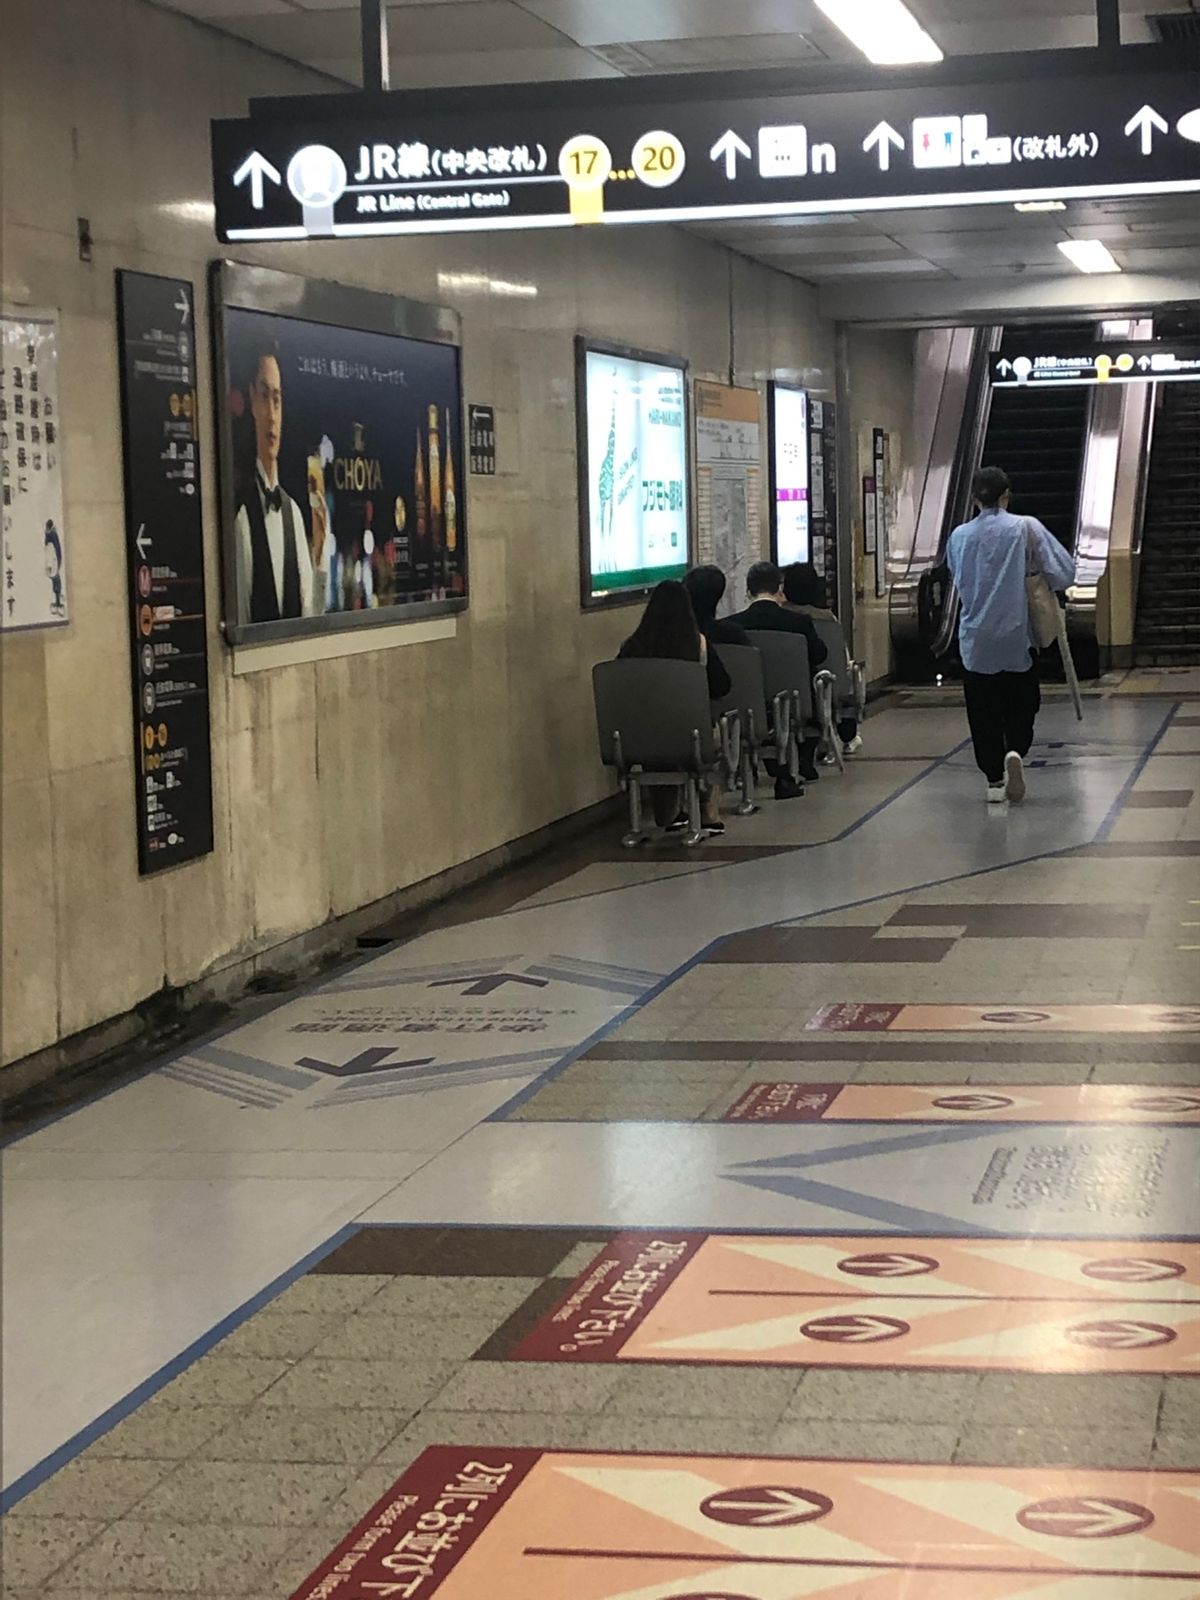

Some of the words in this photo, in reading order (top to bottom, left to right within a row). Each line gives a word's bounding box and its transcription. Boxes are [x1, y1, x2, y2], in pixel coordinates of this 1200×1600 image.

[570, 150, 598, 174] 17
[643, 146, 675, 171] 20
[1013, 132, 1099, 161] (改札外)
[356, 195, 377, 213] JR
[379, 194, 415, 212] Line
[334, 457, 383, 491] CHOYA
[375, 1495, 419, 1526] Please
[352, 1526, 392, 1551] form
